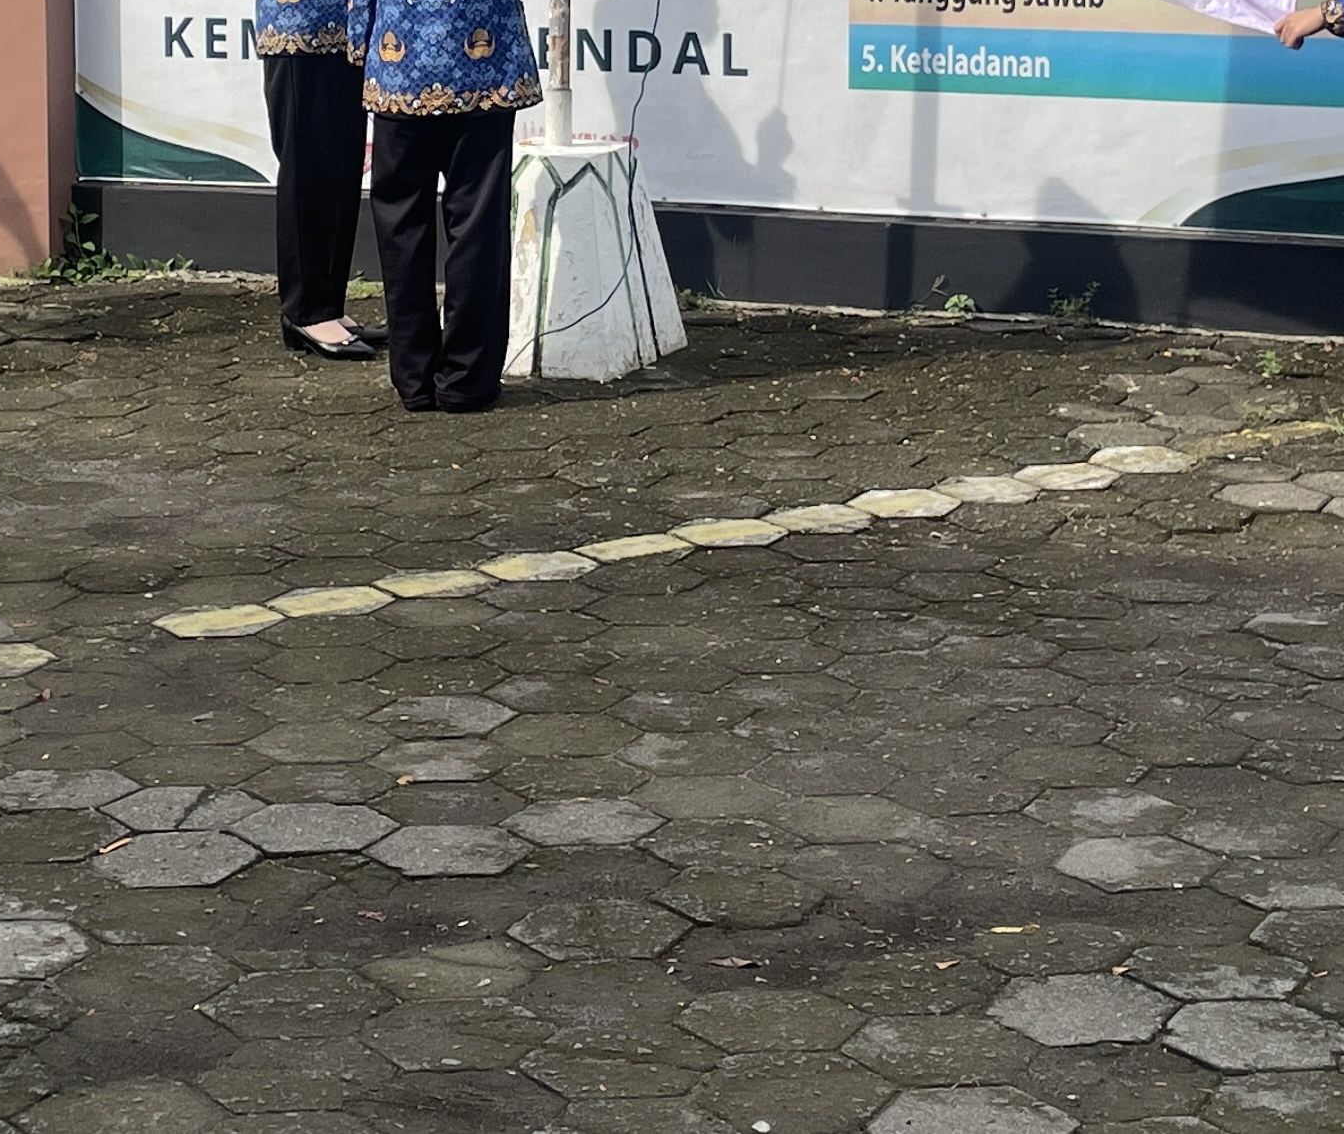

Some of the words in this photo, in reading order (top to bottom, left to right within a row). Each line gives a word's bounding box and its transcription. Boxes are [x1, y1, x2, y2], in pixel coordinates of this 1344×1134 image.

[537, 26, 749, 77] ENDAL
[861, 44, 884, 73] 5.
[889, 44, 1051, 79] Keteladanan
